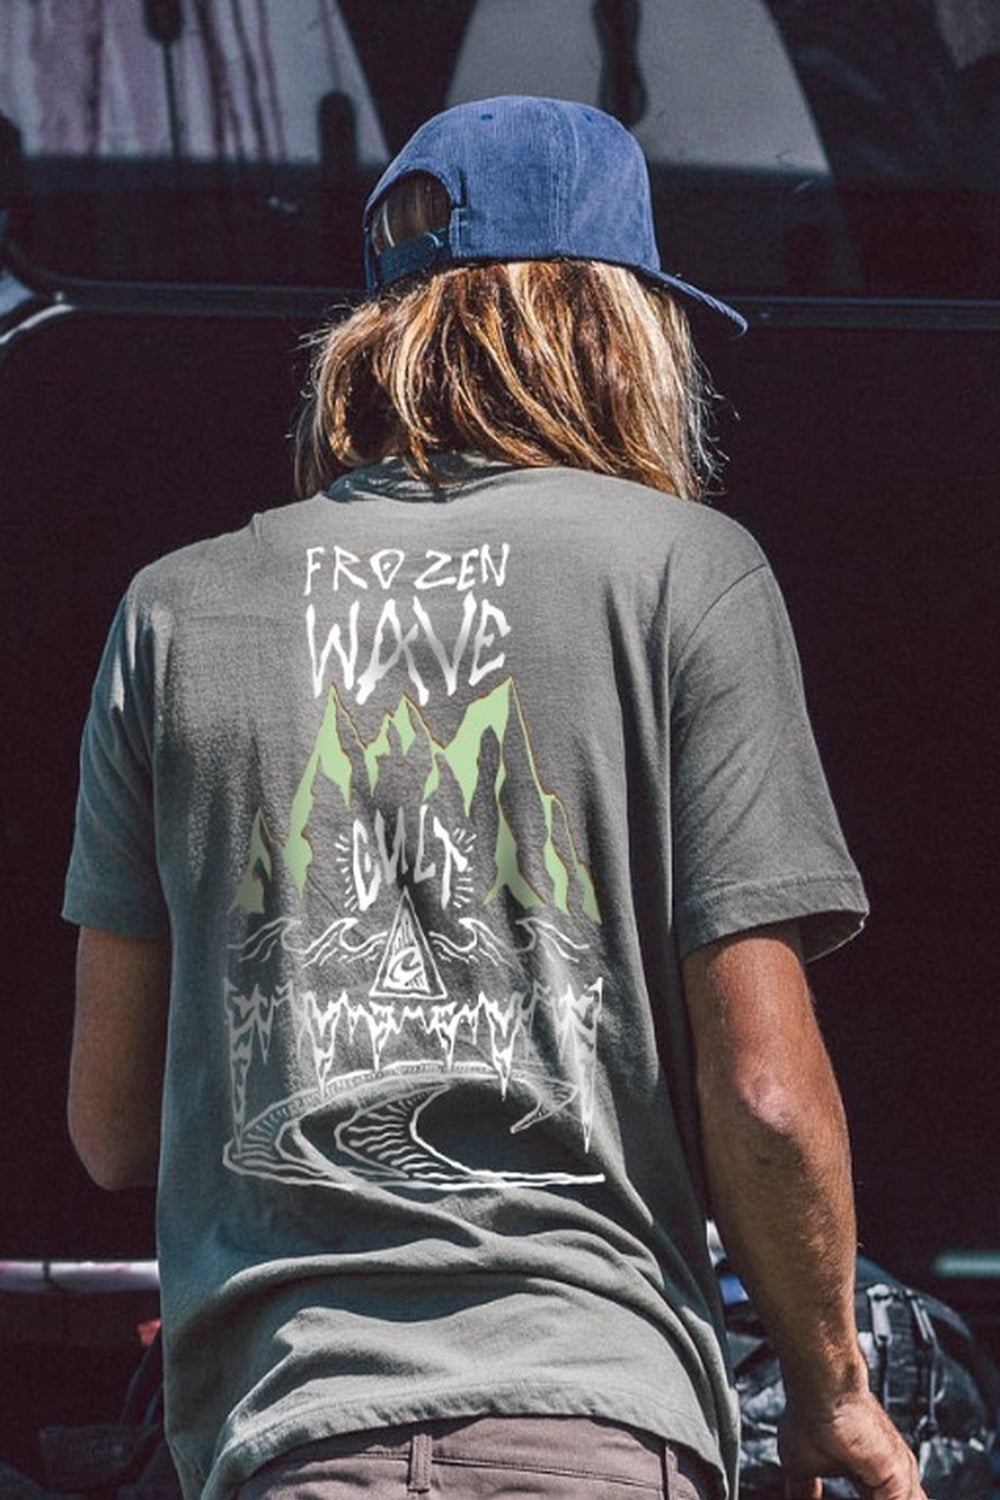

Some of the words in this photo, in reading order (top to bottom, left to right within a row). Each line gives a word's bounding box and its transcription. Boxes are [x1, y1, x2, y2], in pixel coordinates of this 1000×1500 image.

[304, 542, 511, 596] FROZEN
[304, 591, 512, 706] WAVE
[352, 804, 469, 912] CULT
